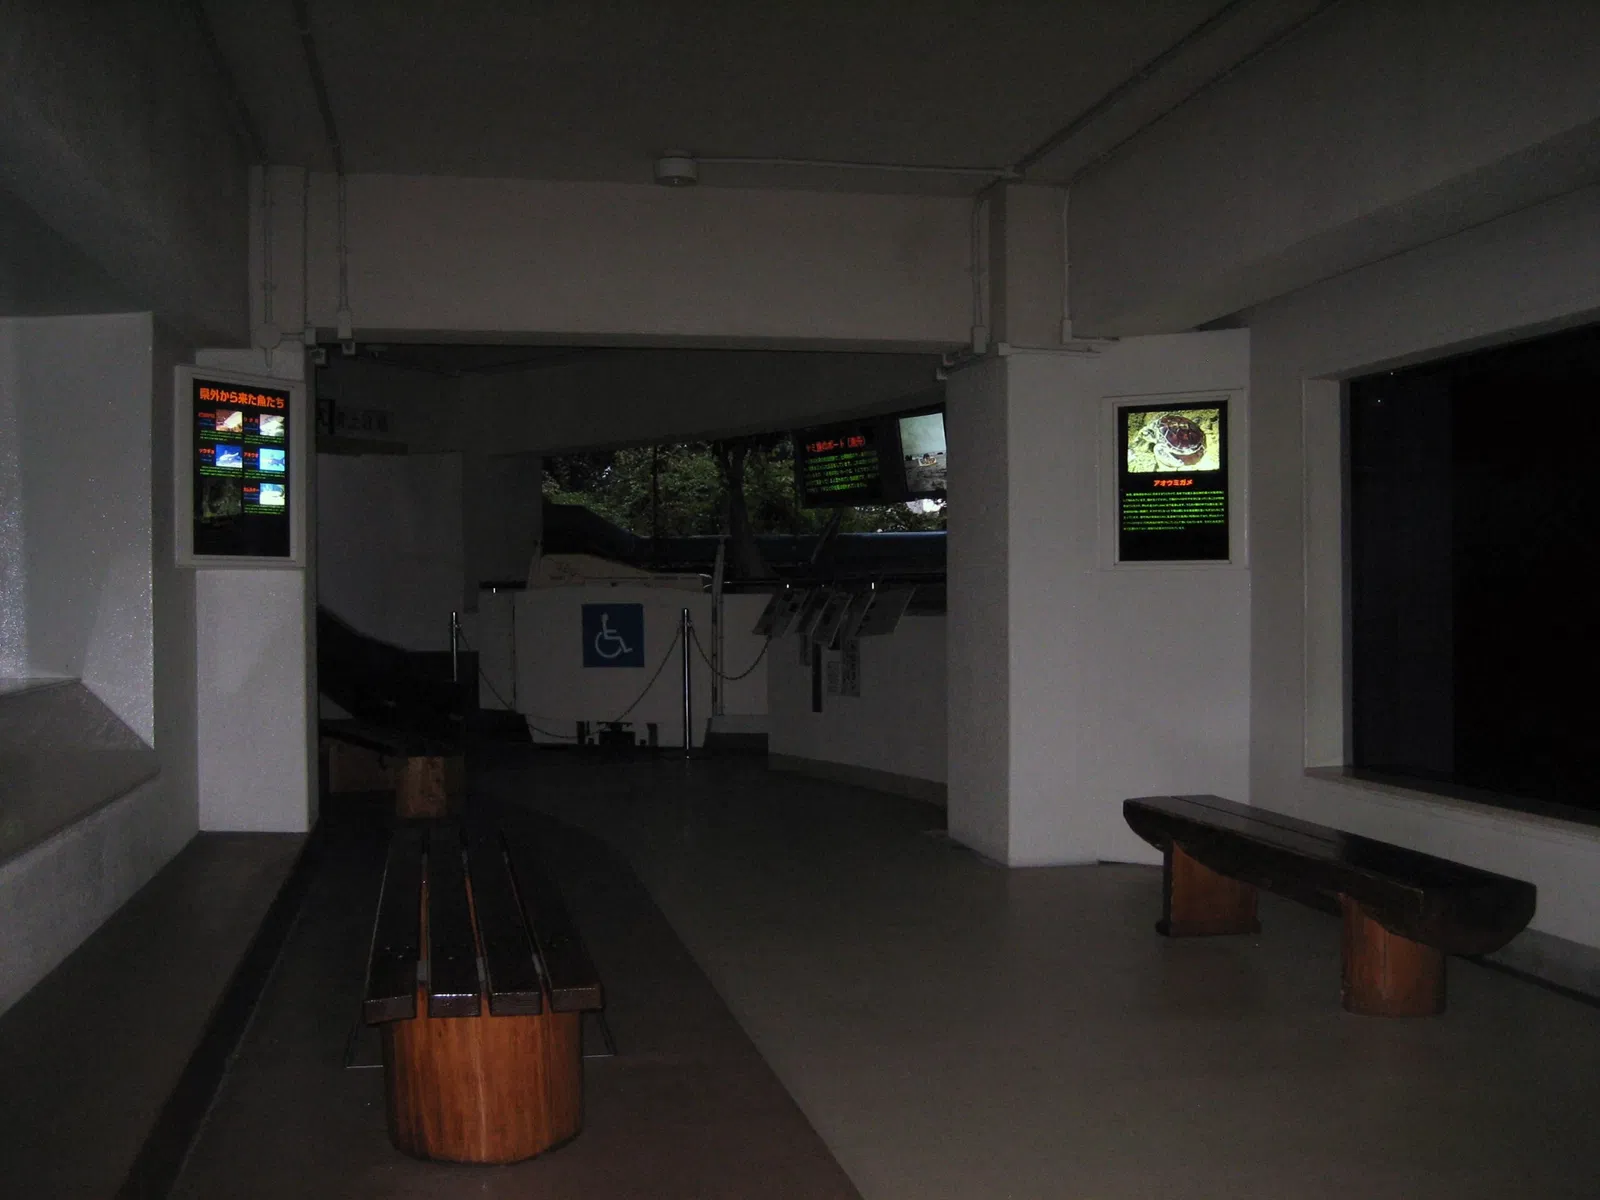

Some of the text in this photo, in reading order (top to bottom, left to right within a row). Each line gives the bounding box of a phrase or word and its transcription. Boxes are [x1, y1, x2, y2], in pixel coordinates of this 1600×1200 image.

[199, 388, 284, 408] 県外から来た魚たち
[1153, 479, 1193, 487] アオウミガメ
